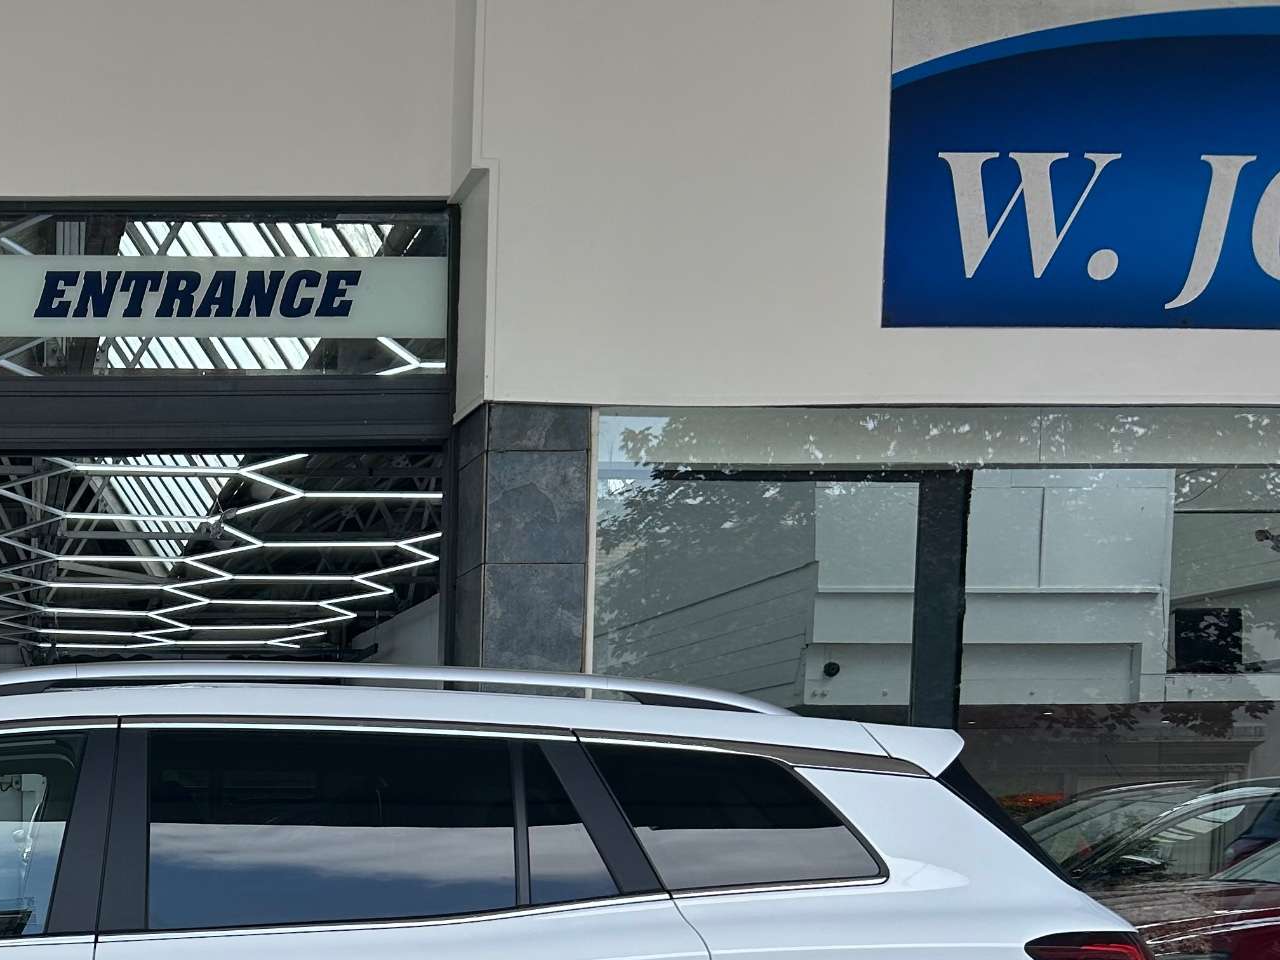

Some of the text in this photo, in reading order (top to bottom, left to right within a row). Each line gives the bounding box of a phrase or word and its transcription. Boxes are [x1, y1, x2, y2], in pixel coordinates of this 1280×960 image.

[937, 151, 1280, 310] W. J
[33, 269, 362, 319] ENTRANCE
